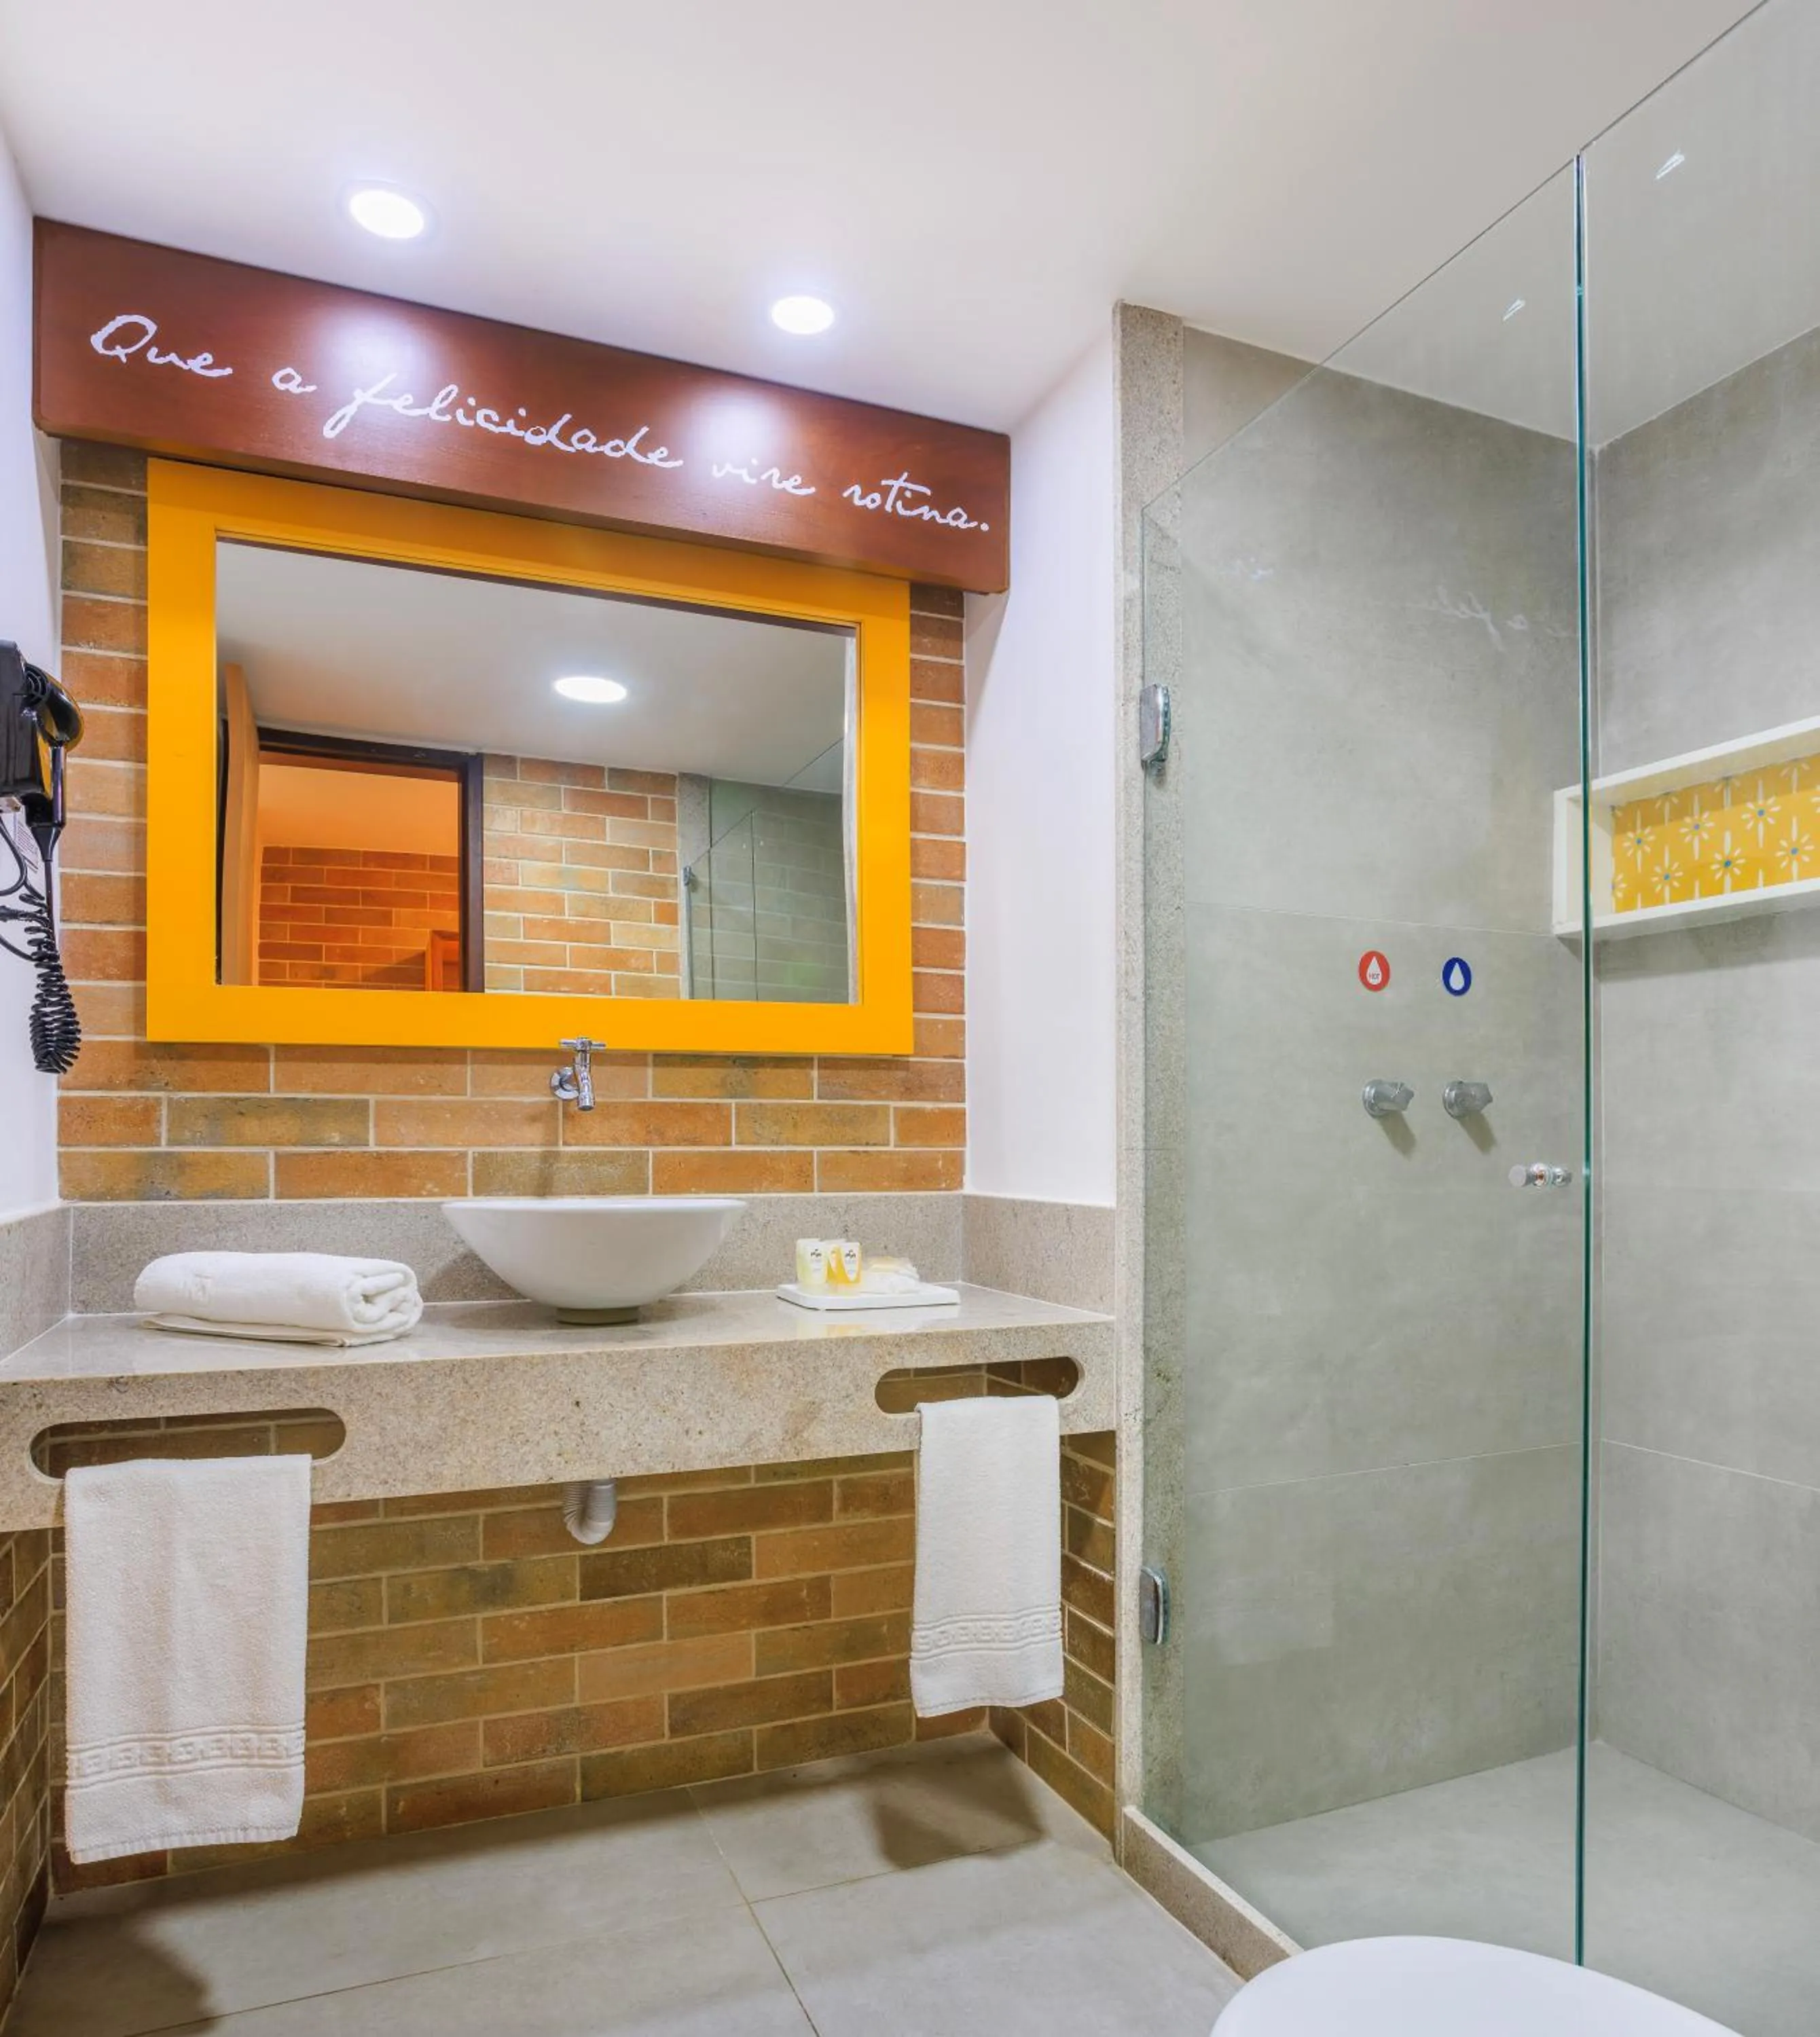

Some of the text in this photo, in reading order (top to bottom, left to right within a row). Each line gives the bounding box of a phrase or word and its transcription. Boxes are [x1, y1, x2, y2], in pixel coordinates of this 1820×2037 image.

[90, 314, 989, 531] Que a felicidade vire rotina.
